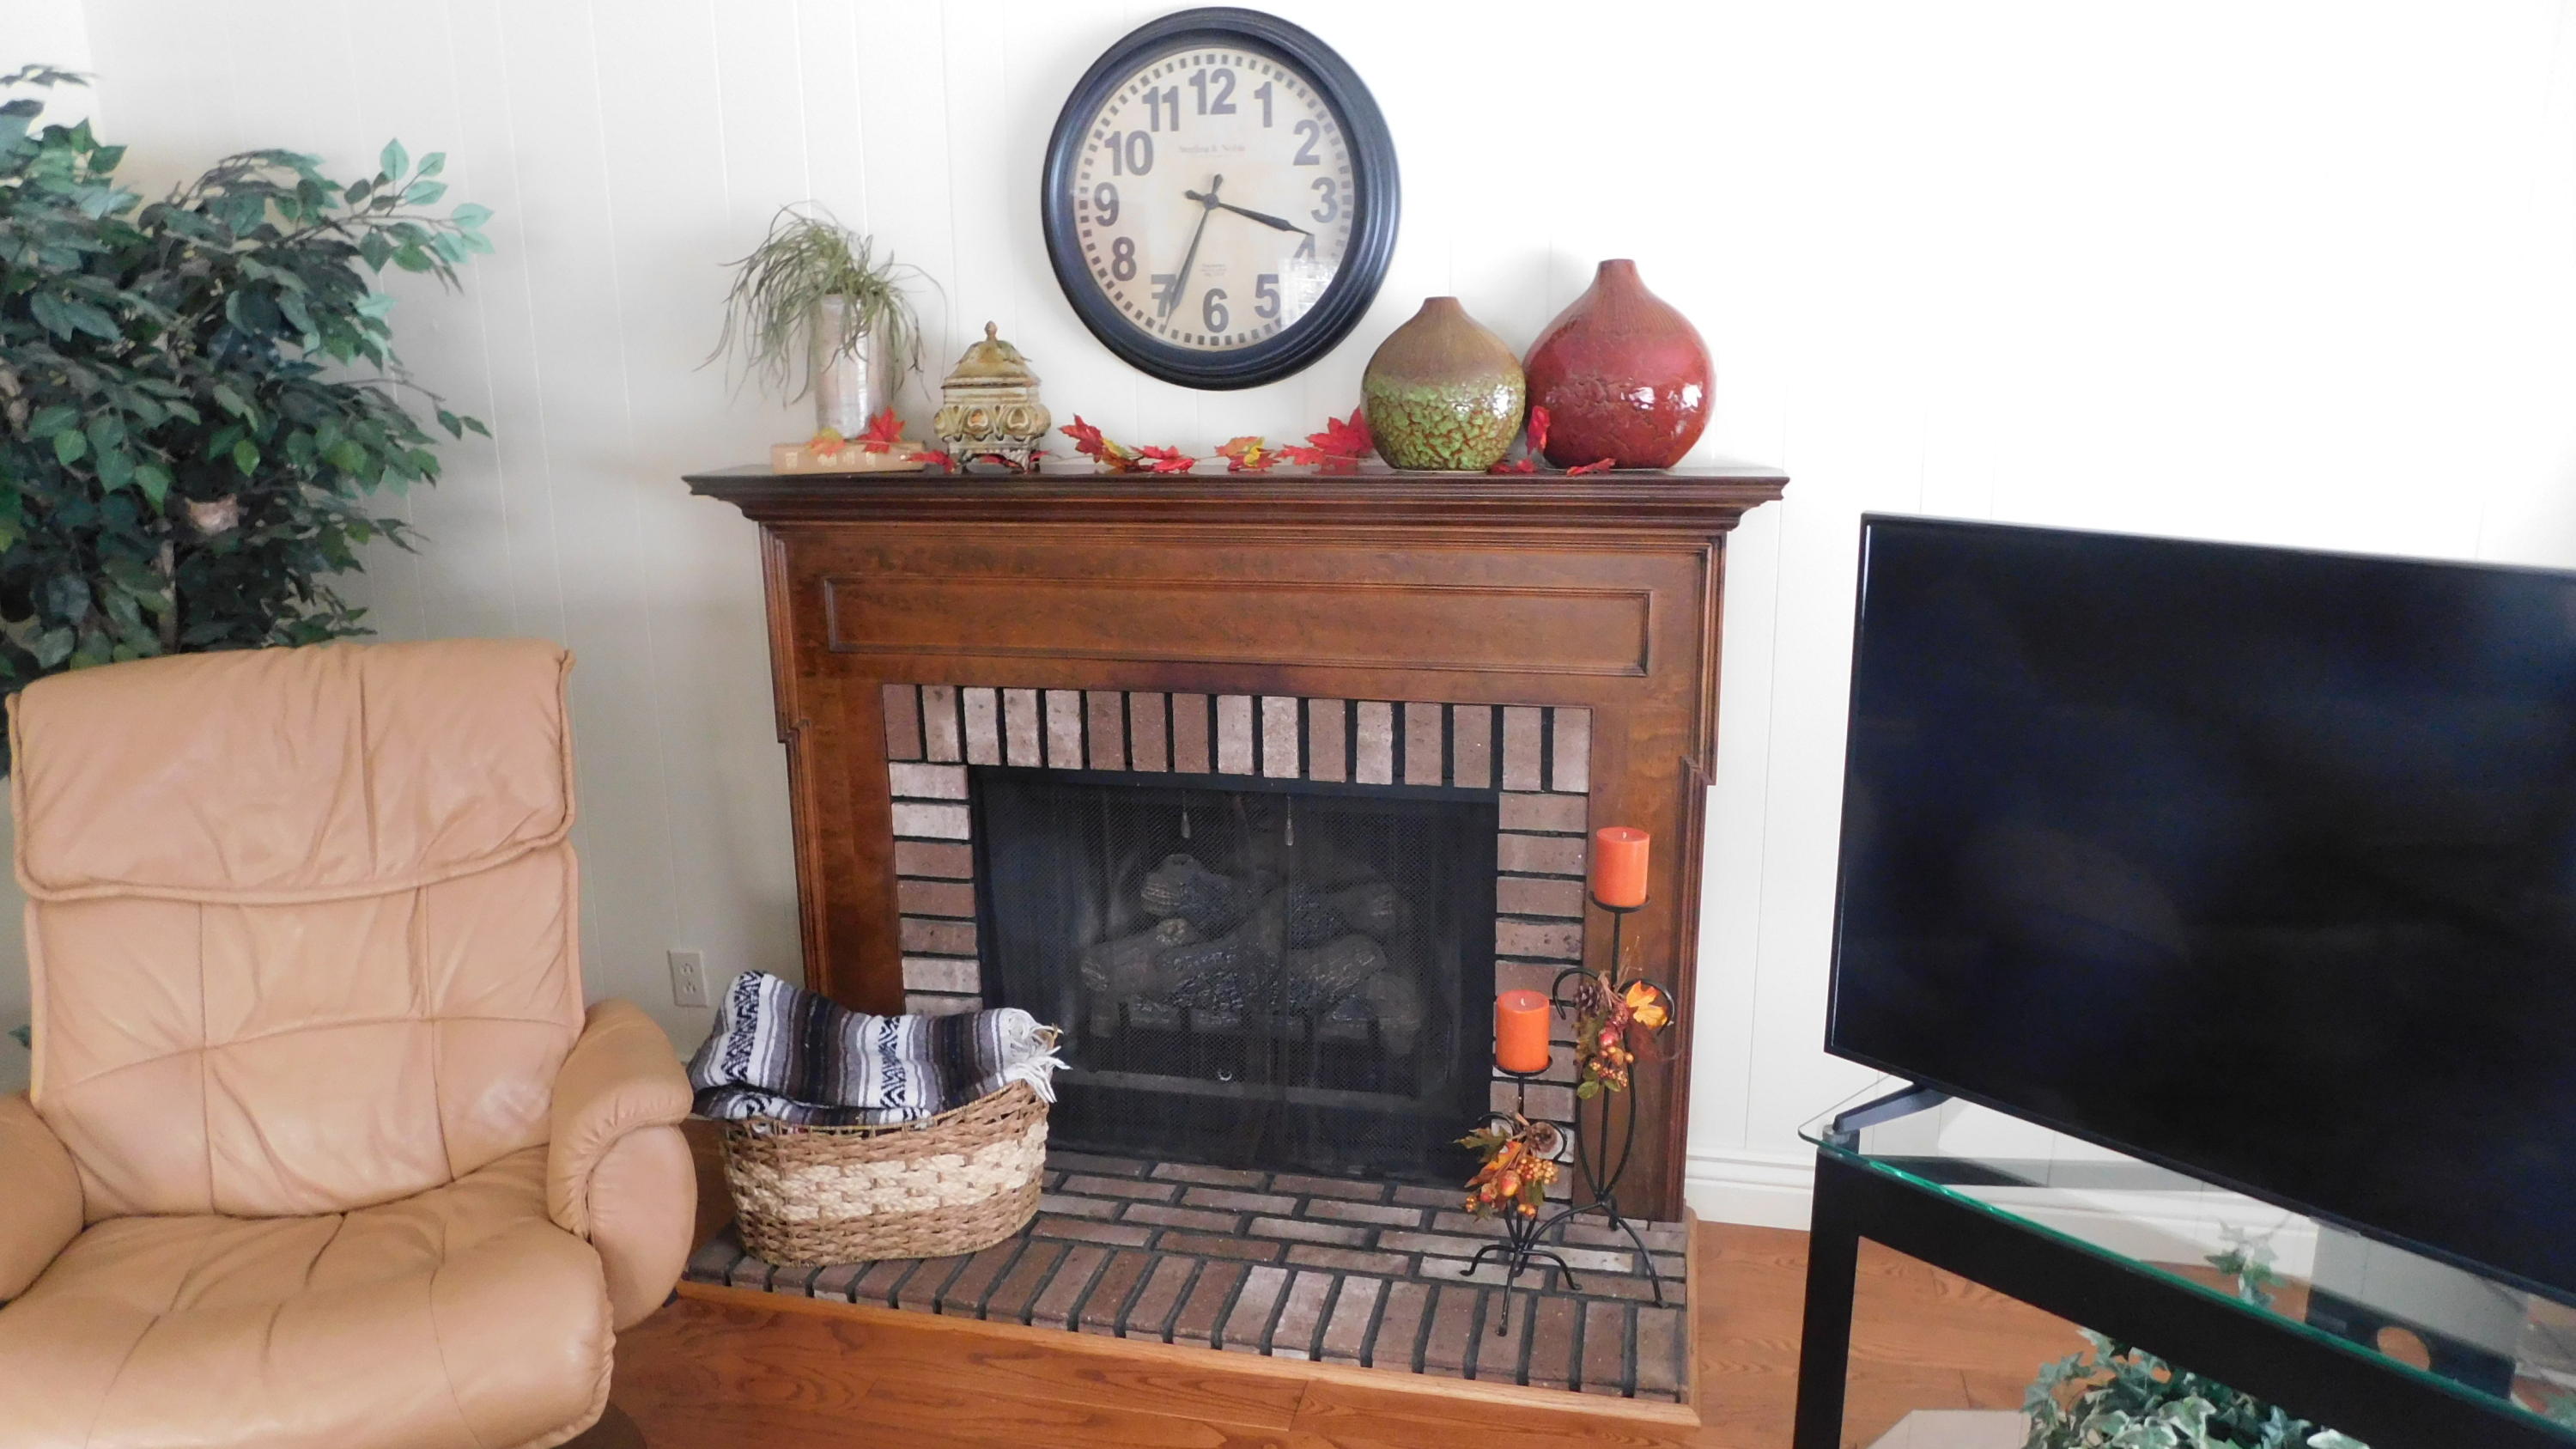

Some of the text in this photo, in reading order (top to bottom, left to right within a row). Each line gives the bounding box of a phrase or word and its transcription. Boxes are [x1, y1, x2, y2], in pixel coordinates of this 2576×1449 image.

[1142, 86, 1180, 132] 11
[1188, 68, 1236, 115] 12
[1254, 82, 1273, 128] 1
[1104, 130, 1154, 177] 10
[1292, 119, 1321, 166] 2
[1093, 182, 1120, 227] 9
[1310, 177, 1339, 223] 3
[1111, 236, 1138, 282] 8
[1151, 274, 1177, 318] 7
[1202, 288, 1229, 333] 6
[1254, 273, 1281, 320] 5
